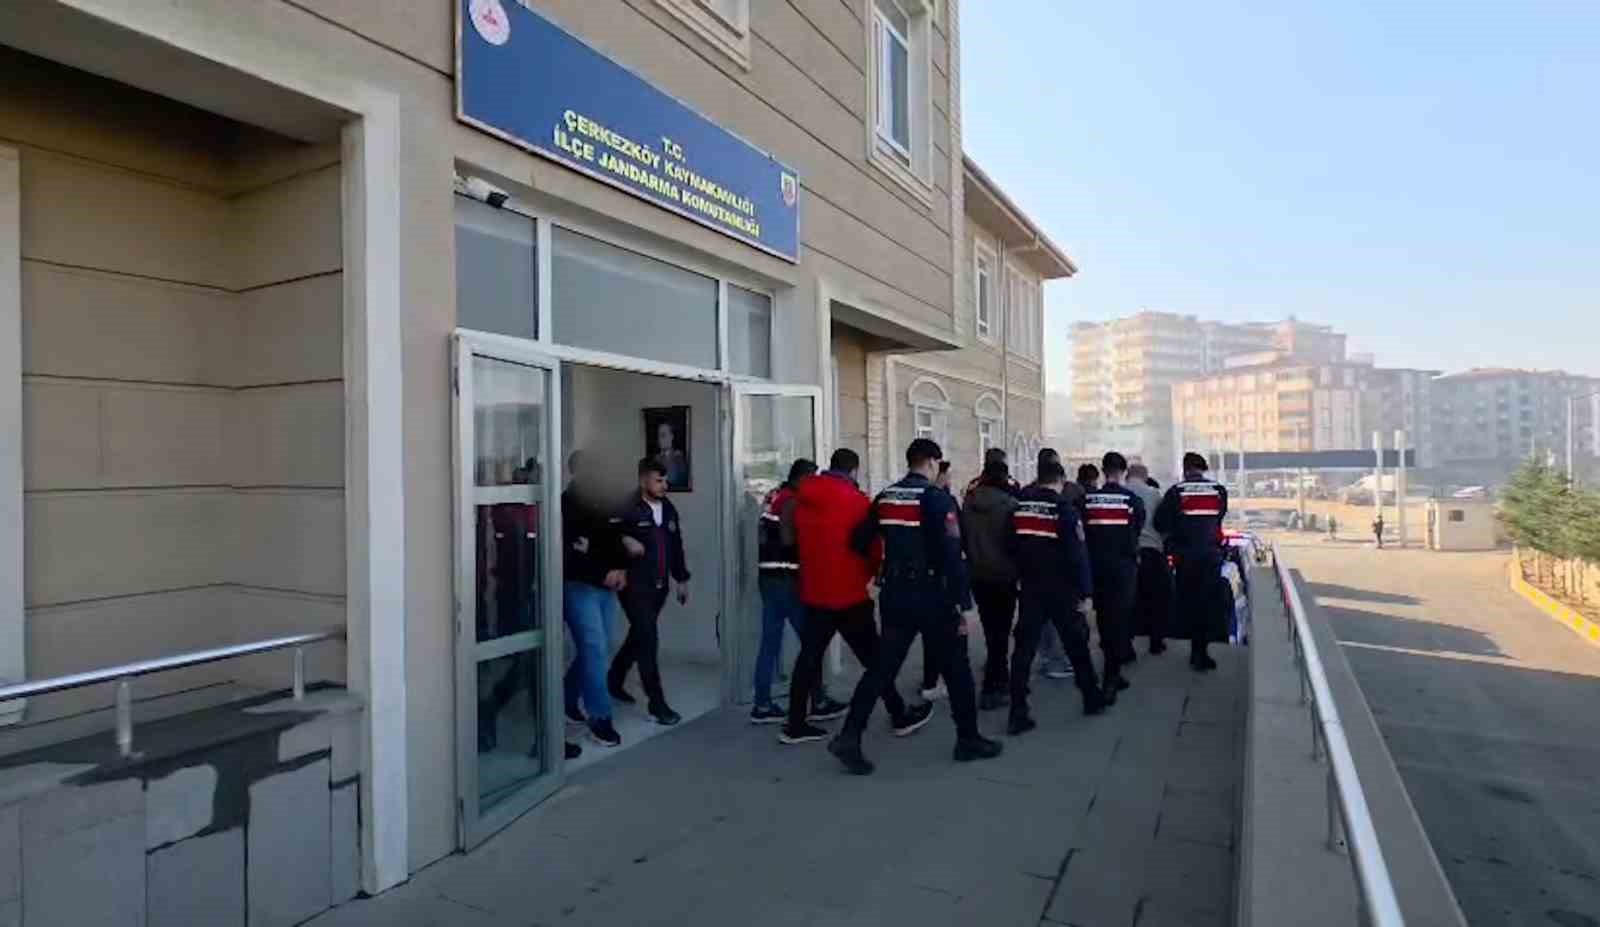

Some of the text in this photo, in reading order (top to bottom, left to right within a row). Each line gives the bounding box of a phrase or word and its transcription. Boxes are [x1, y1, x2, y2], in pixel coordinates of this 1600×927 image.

[554, 124, 594, 160] İLÇE
[600, 152, 679, 199] JANDARMA
[564, 110, 660, 168] ÇERKEZKÖY
[662, 136, 686, 162] T.C.
